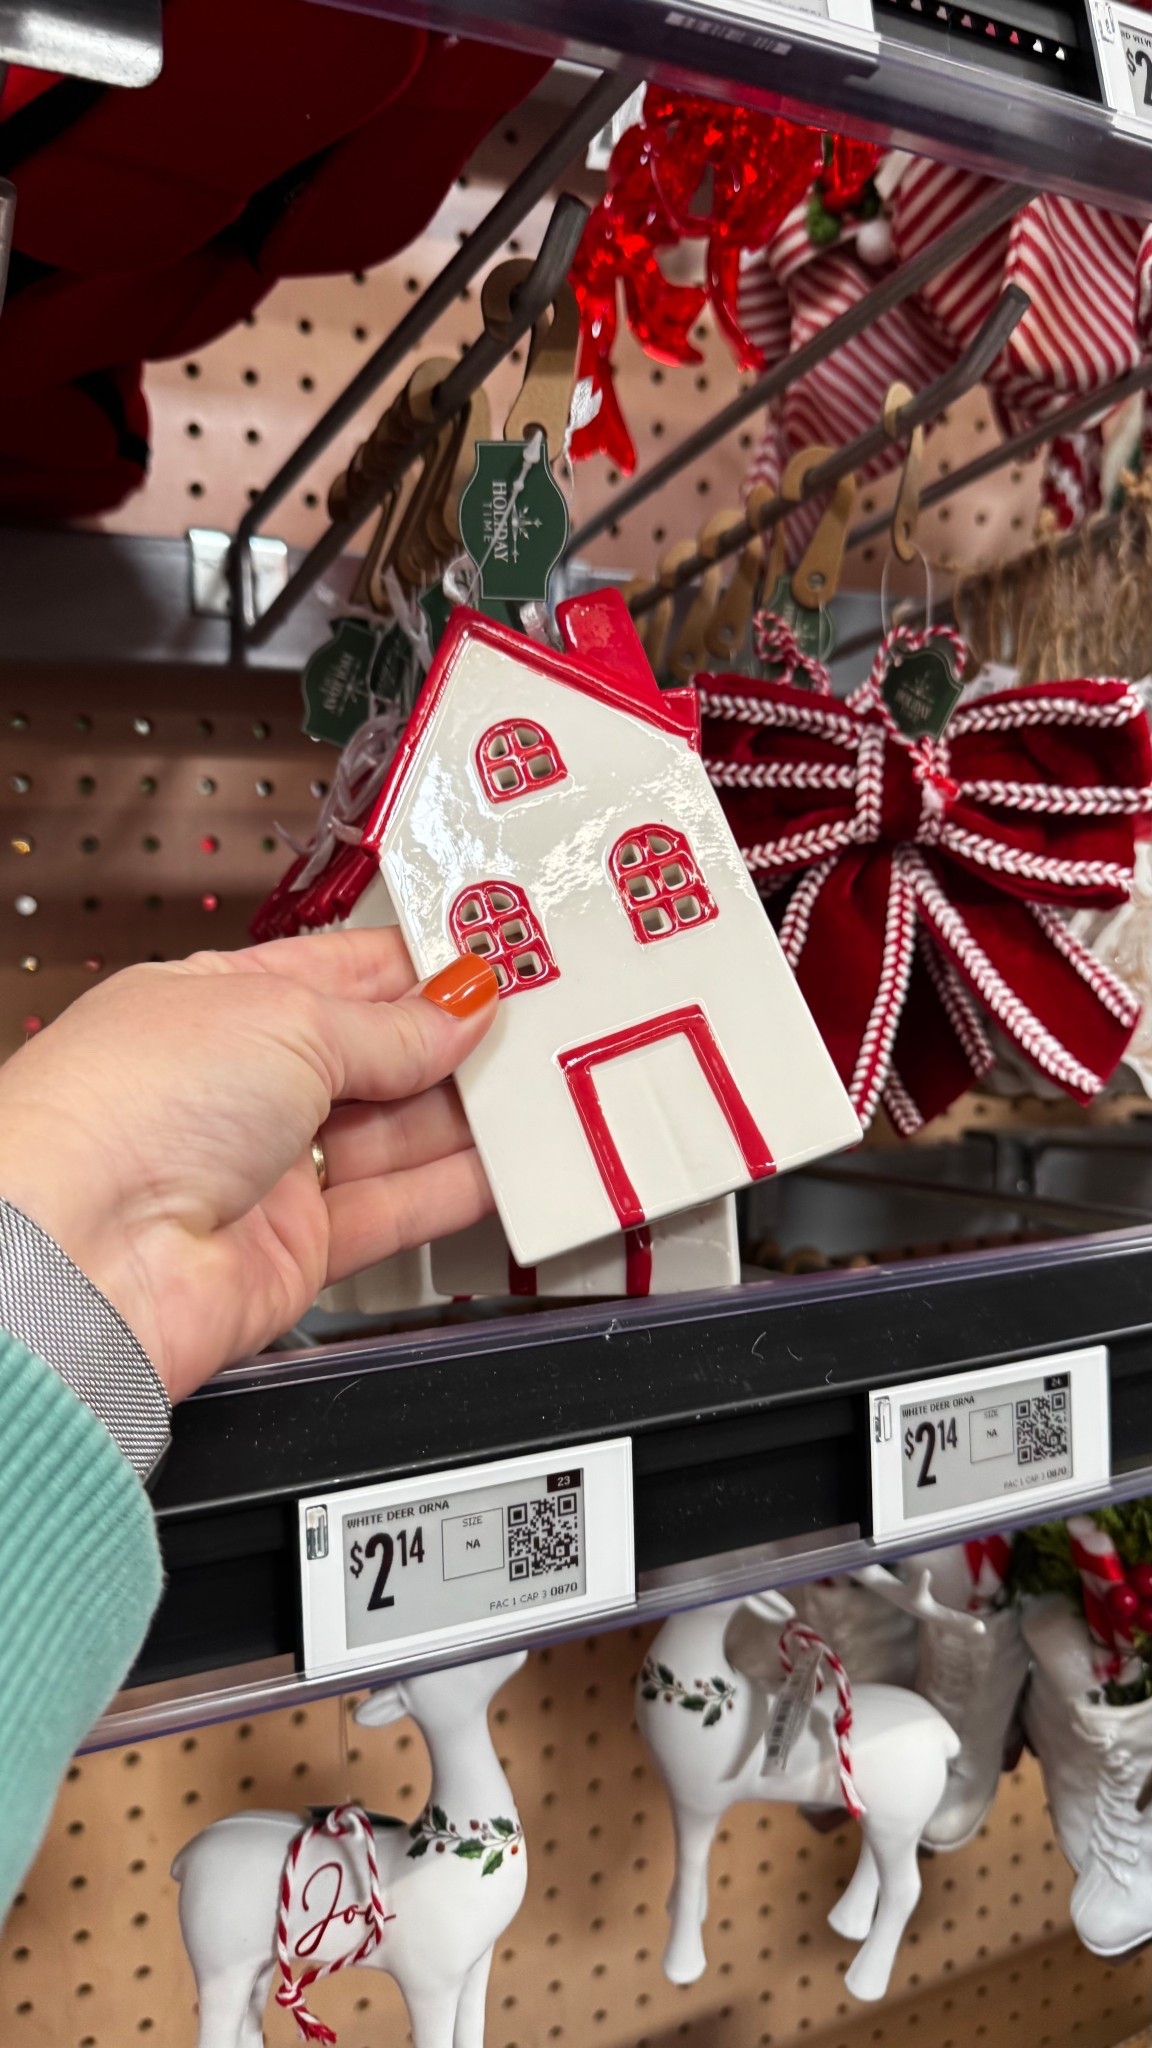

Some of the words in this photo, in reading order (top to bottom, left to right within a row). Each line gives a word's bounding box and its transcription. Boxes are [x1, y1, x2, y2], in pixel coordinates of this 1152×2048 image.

[482, 502, 493, 543] TIME
[902, 1406, 928, 1418] WHITE
[930, 1400, 950, 1412] DEER
[952, 1395, 975, 1407] ORNA
[986, 1428, 998, 1438] NA
[557, 1475, 571, 1487] 23
[347, 1513, 383, 1529] WHITE
[386, 1507, 415, 1521] DEER
[418, 1500, 450, 1515] ORNA
[462, 1516, 483, 1527] SIZE
[465, 1539, 481, 1550] NA
[489, 1598, 510, 1611] FAC
[520, 1592, 539, 1603] CAP
[550, 1582, 578, 1597] 0870
